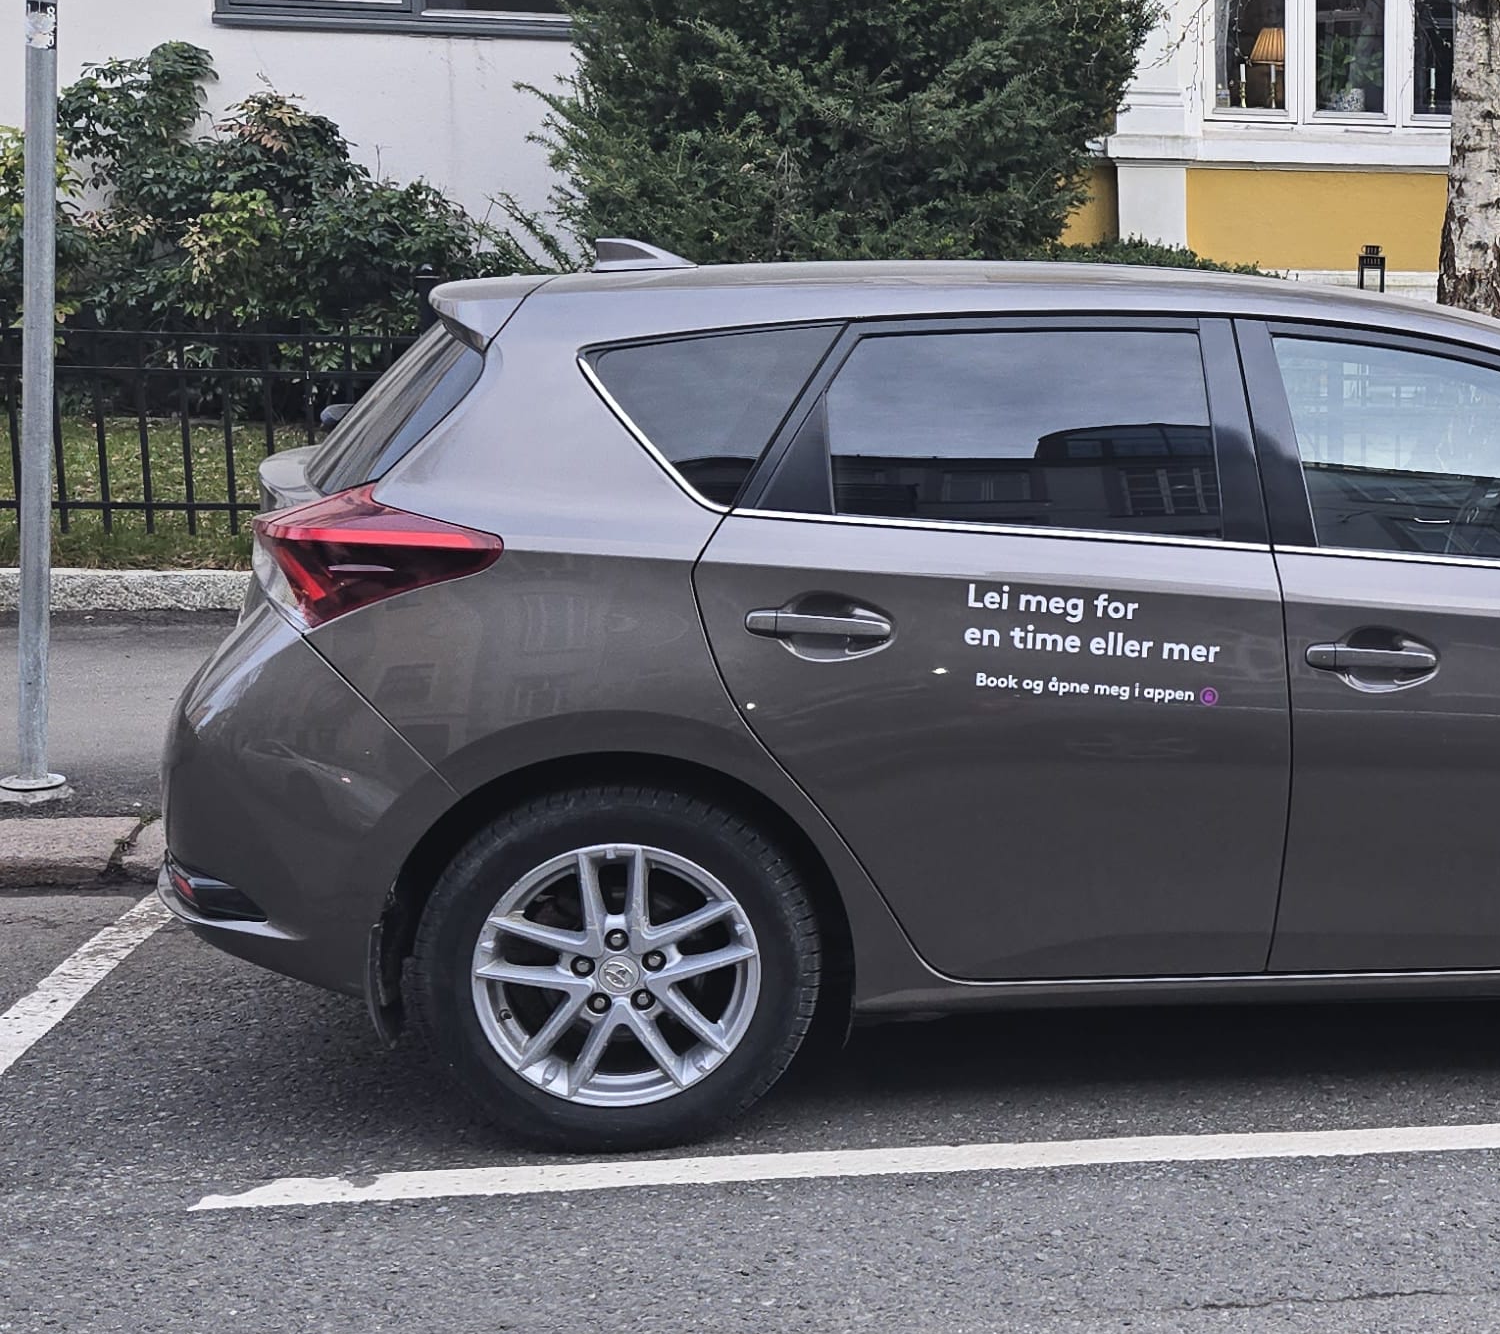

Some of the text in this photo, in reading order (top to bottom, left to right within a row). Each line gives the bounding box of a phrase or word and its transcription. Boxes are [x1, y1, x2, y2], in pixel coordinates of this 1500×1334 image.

[967, 583, 1139, 623] Lei meg for
[963, 624, 1220, 663] en time eller mer
[975, 672, 1195, 703] Book og åpne meg i appen
